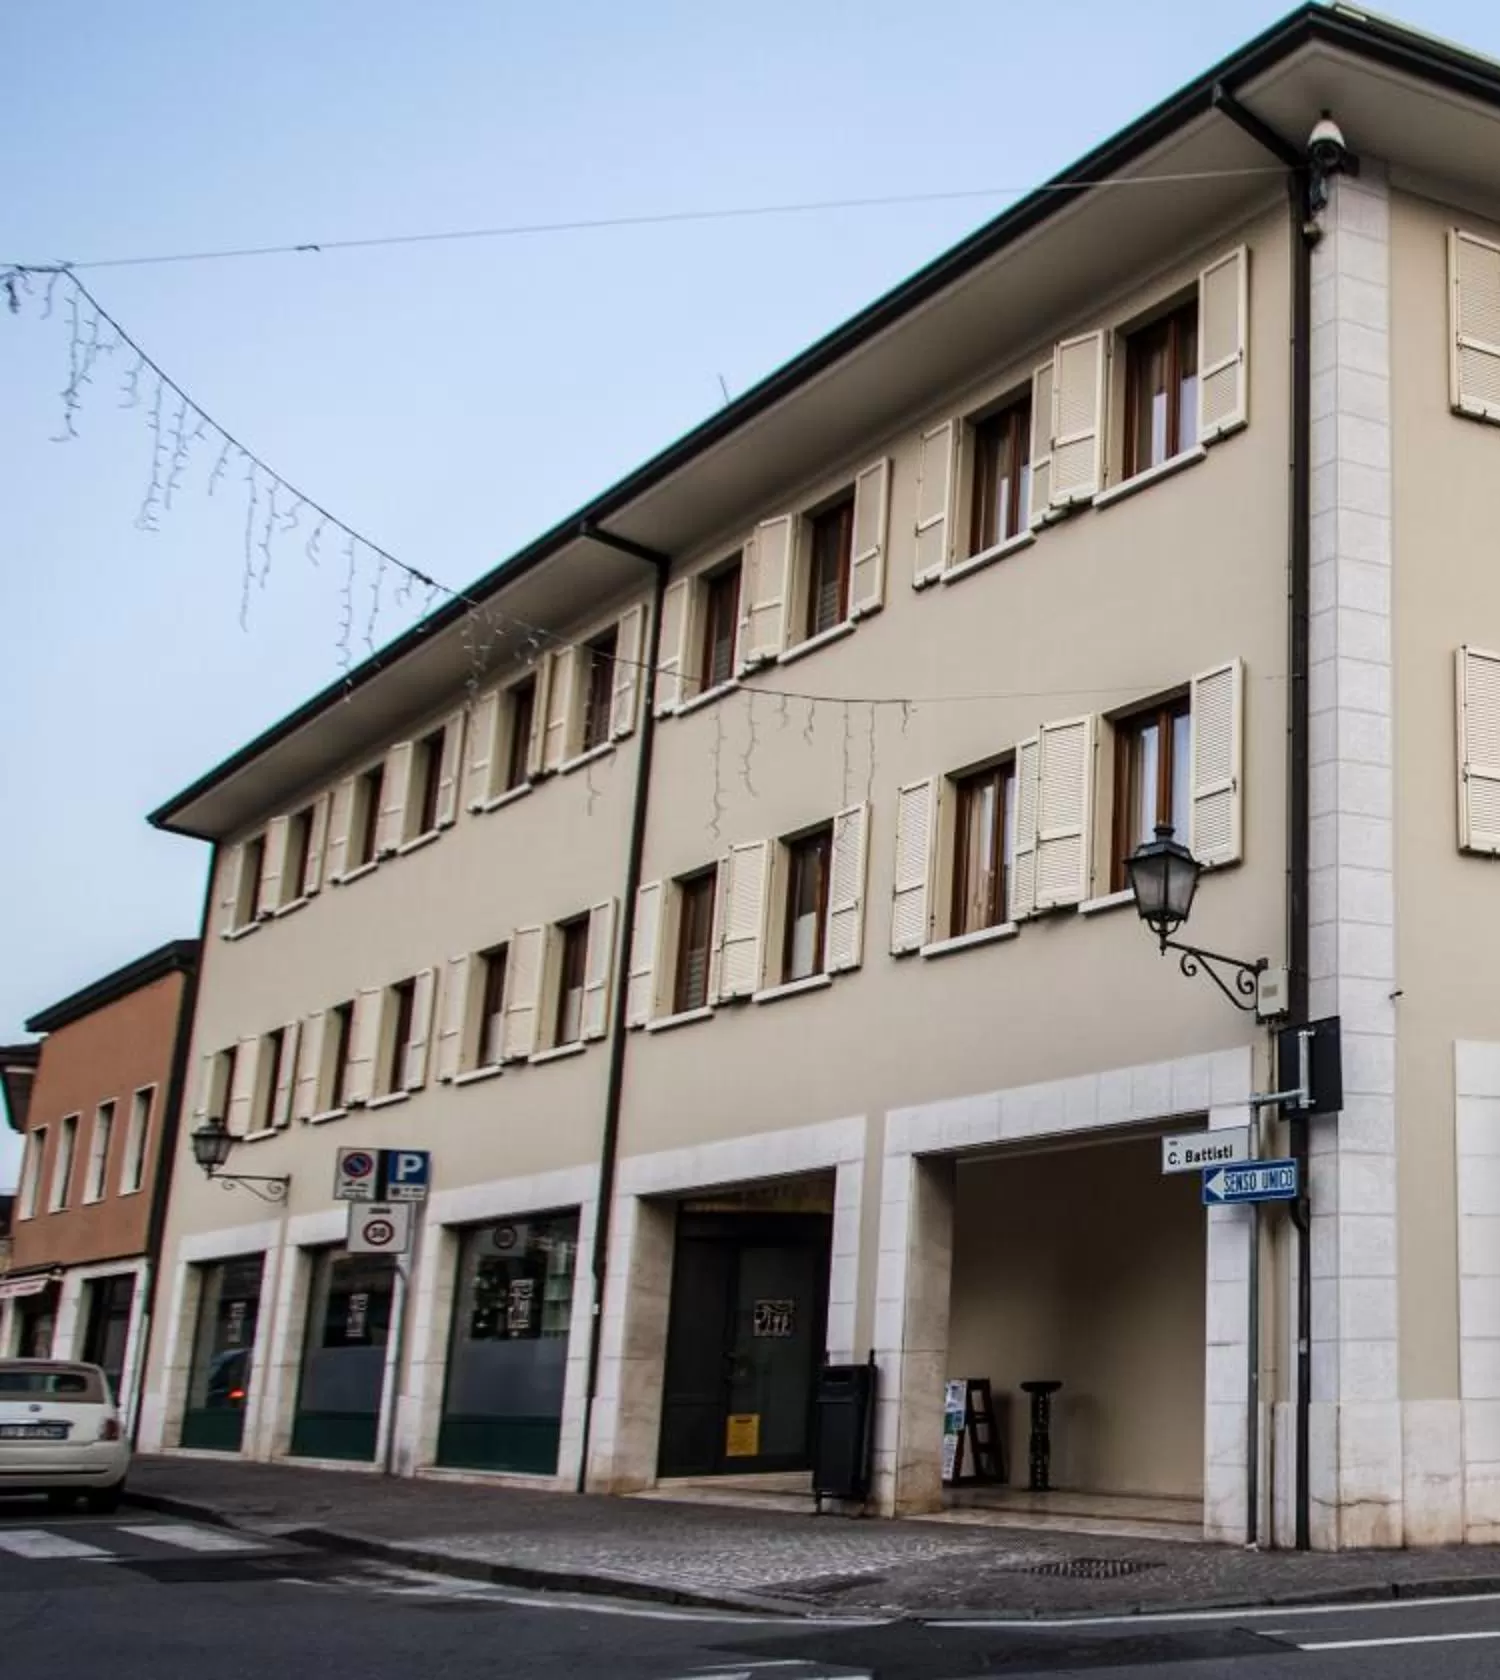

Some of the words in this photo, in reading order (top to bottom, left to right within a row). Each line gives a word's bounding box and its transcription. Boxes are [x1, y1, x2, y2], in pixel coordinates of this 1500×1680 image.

[1167, 1151, 1181, 1165] C.
[1185, 1144, 1233, 1163] Battisti
[396, 1154, 423, 1181] P
[1223, 1171, 1257, 1193] SENSO
[1261, 1168, 1293, 1190] UNICO
